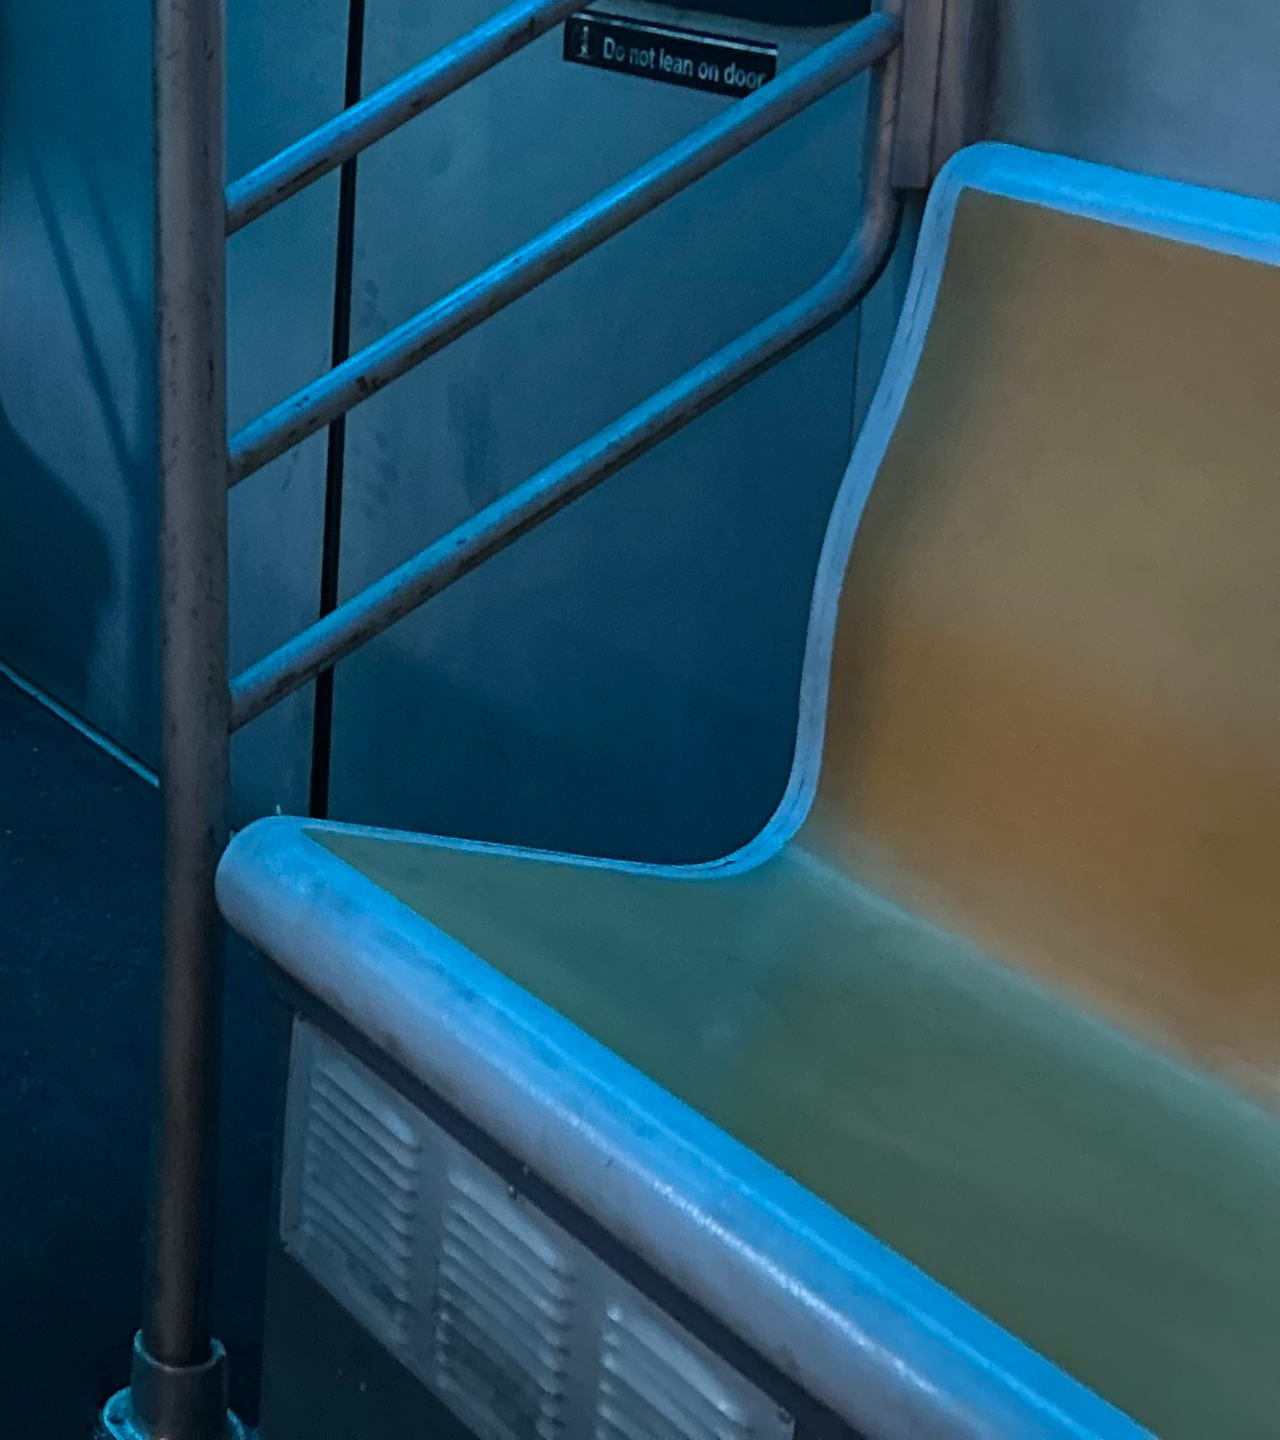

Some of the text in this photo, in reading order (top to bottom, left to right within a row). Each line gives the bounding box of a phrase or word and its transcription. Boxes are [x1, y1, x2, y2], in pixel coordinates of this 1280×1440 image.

[602, 36, 767, 89] Do not lean on door
